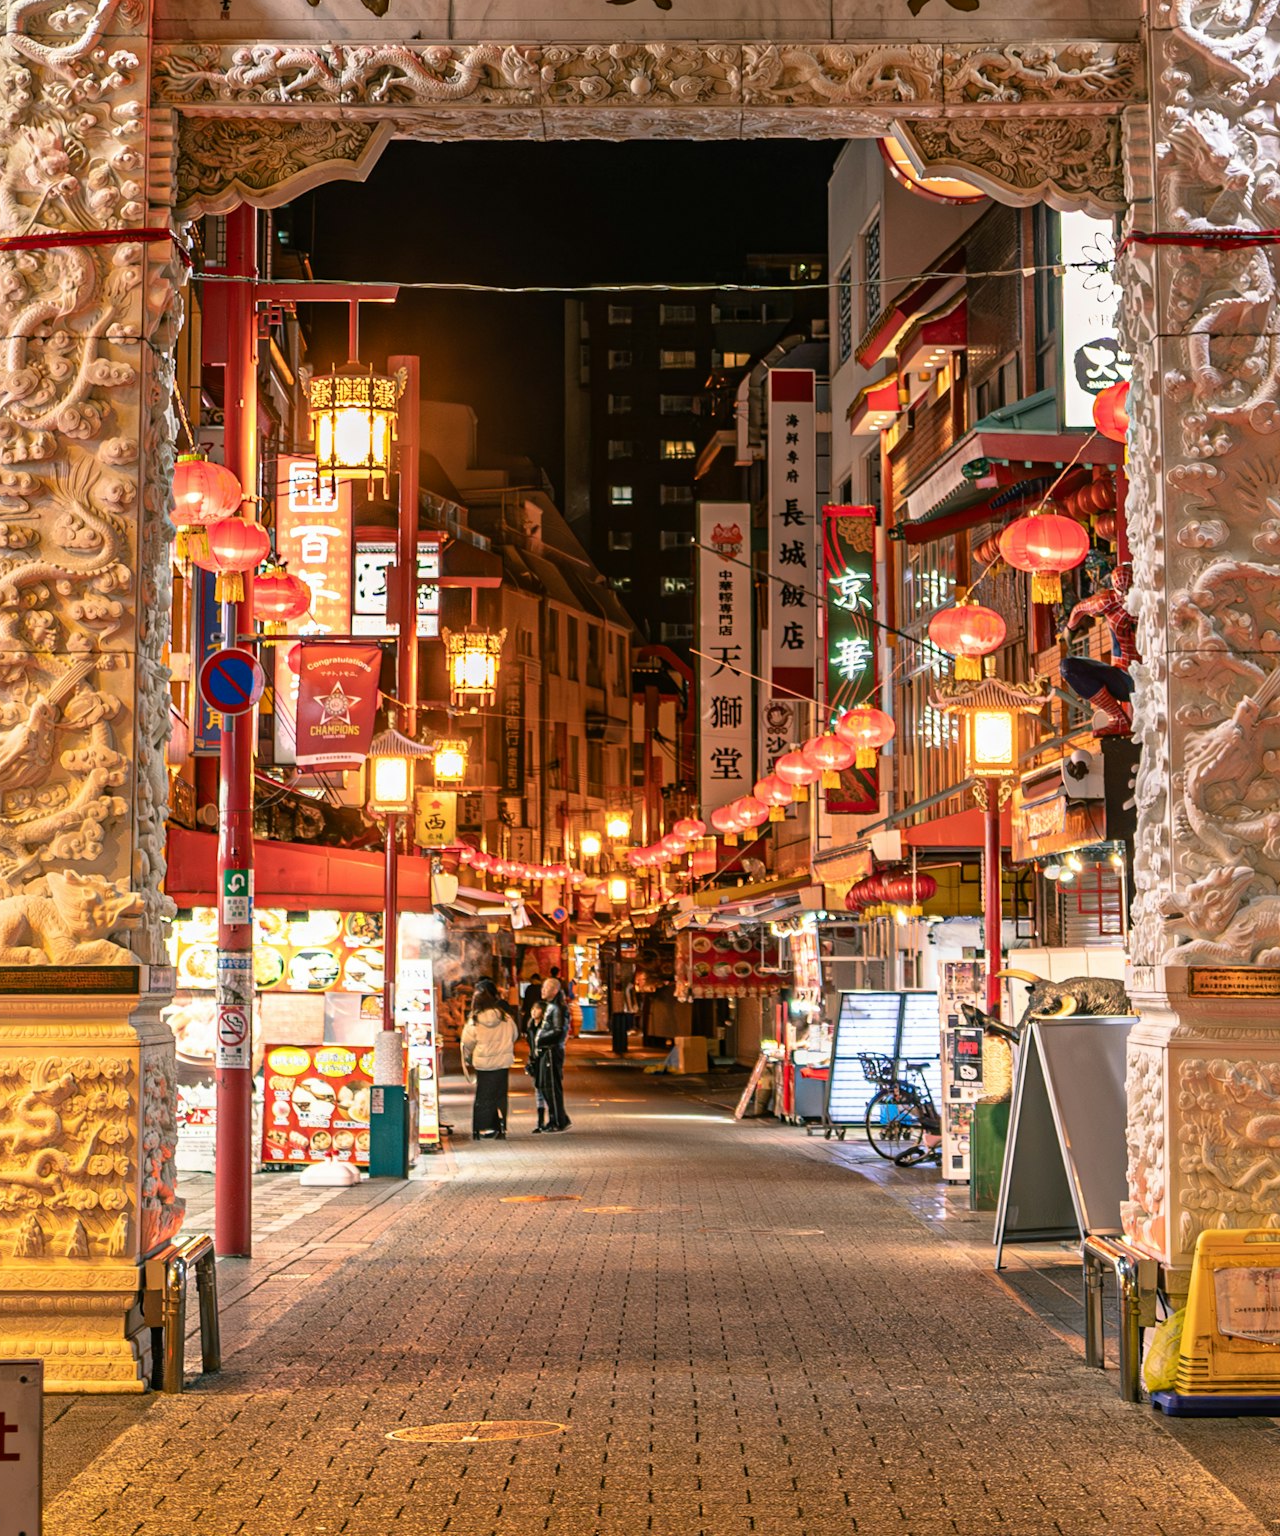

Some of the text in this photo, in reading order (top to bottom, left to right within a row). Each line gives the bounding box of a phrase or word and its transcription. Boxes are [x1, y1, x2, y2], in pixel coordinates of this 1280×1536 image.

[779, 498, 808, 650] 長城飯店
[306, 656, 372, 673] Congratulations
[310, 725, 360, 736] CHAMPIONS
[709, 644, 743, 780] 天獅堂
